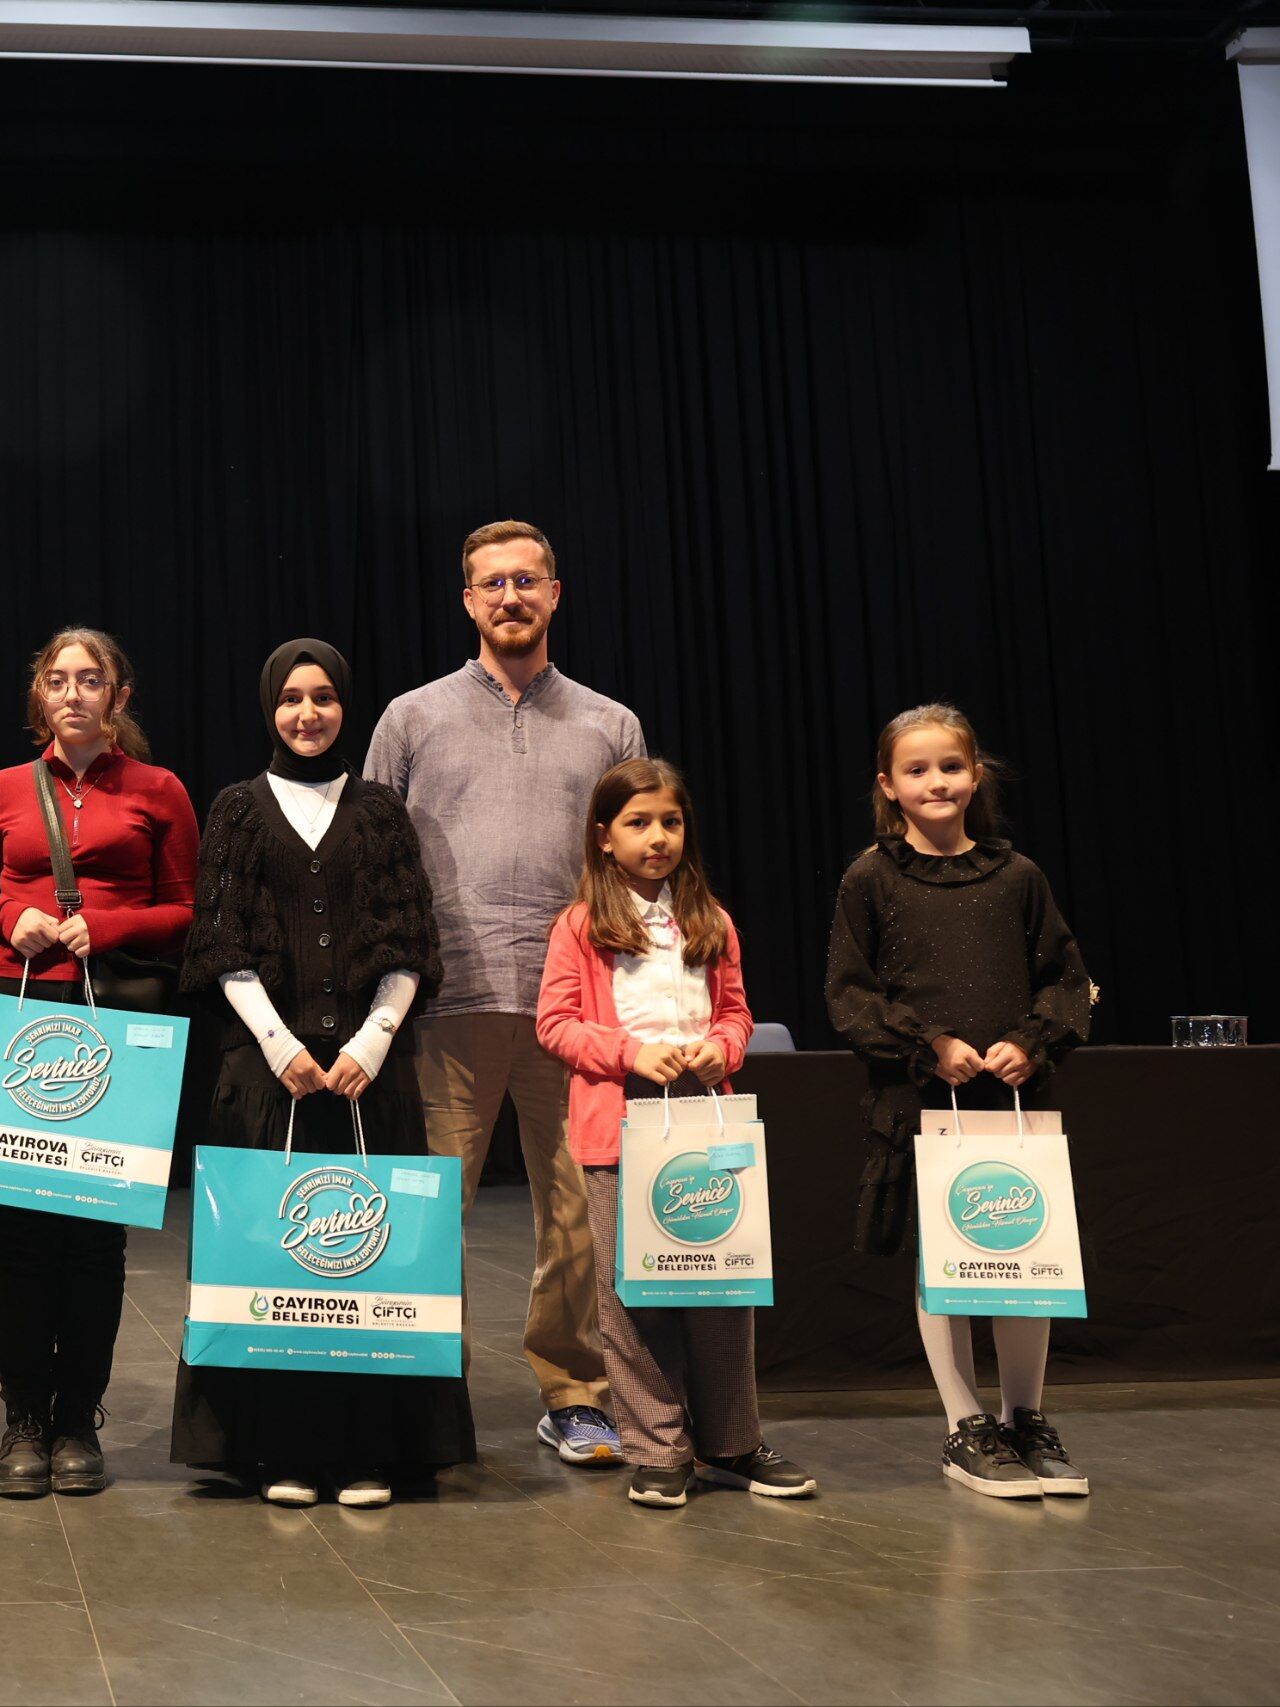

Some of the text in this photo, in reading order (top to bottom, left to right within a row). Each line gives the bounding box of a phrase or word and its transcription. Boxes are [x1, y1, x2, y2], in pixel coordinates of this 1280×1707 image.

[1, 1044, 112, 1090] Sevince
[663, 1176, 733, 1214] Sevince
[961, 1186, 1036, 1221] Sevince
[281, 1193, 387, 1249] Sevince
[657, 1254, 716, 1264] ÇAYIROVA
[958, 1261, 1021, 1271] ÇAYIROVA
[272, 1296, 359, 1312] ÇAYIROVA
